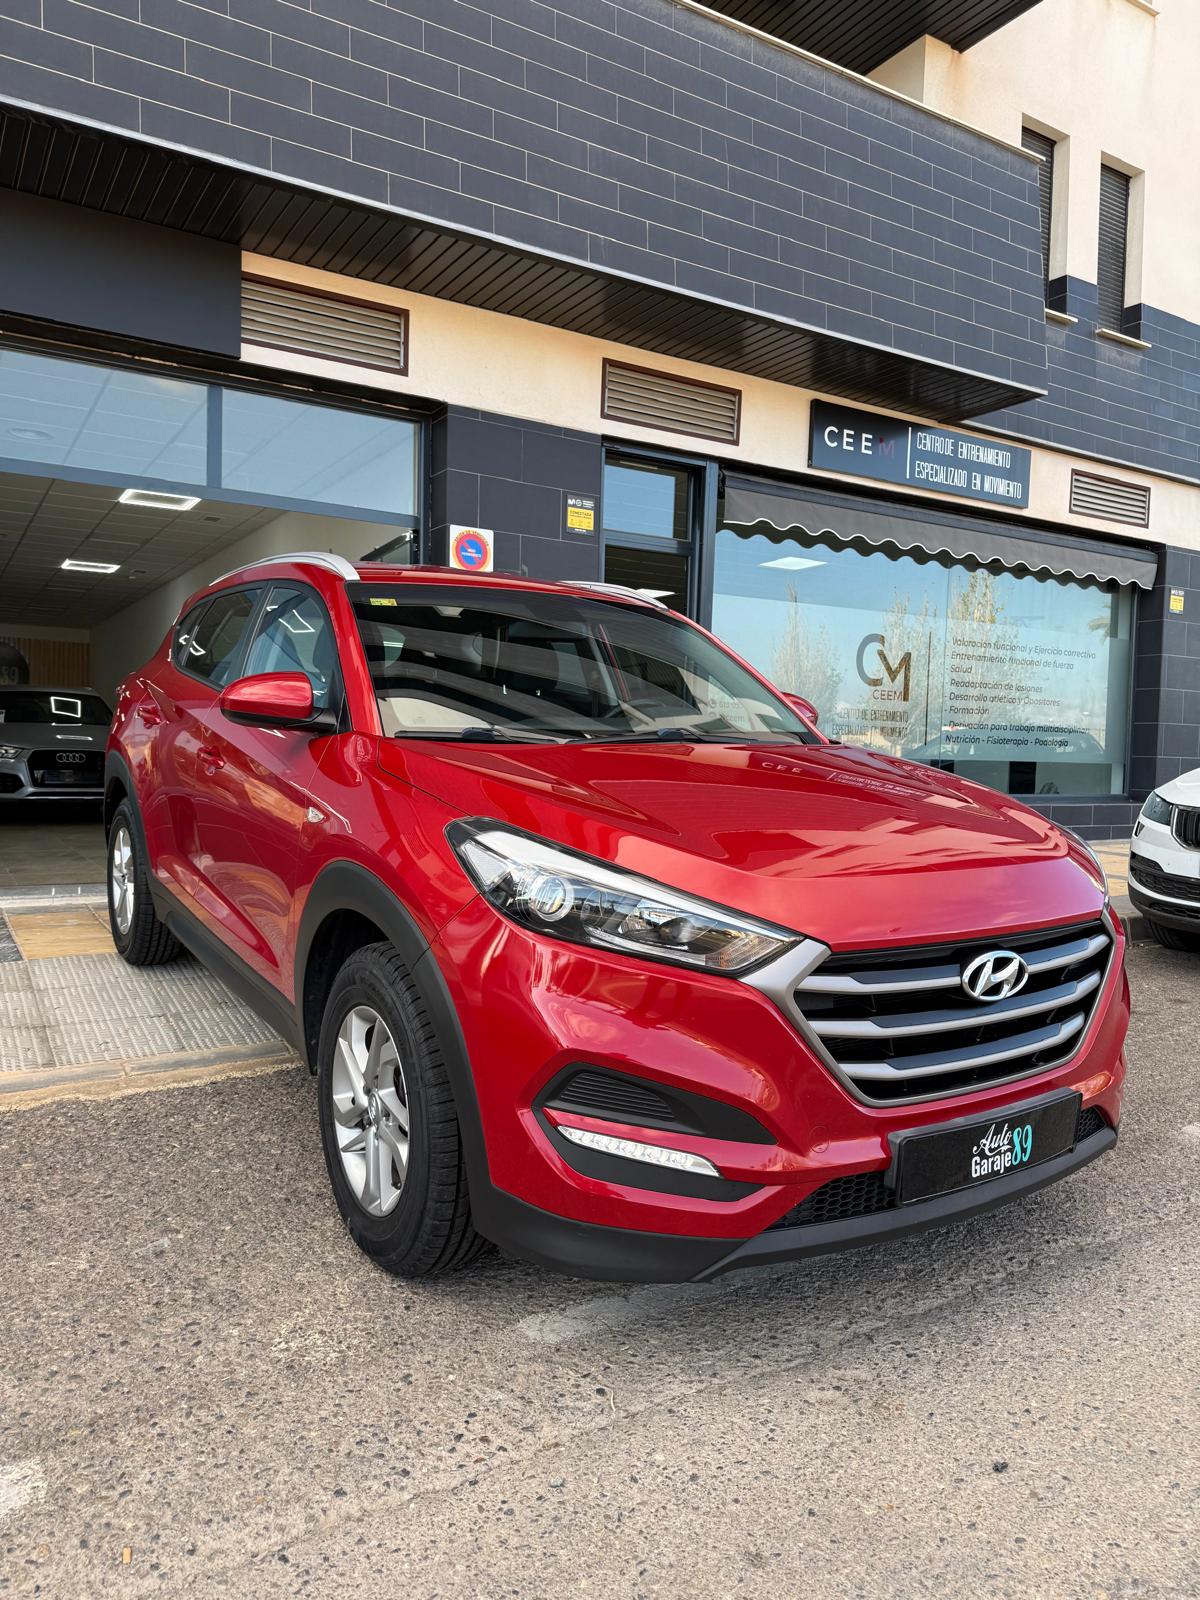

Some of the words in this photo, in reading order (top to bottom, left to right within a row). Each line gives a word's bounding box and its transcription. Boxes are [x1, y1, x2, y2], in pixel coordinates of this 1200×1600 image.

[917, 432, 944, 454] CENTRO
[944, 439, 955, 457] DE
[958, 441, 1011, 469] ENTRENAMIENTO
[915, 461, 968, 488] ESPECIALIZADO
[972, 473, 981, 491] EN
[984, 475, 1022, 499] MOVIMIENTO
[993, 641, 1028, 652] funcional
[1034, 645, 1063, 656] Ejercicio
[1064, 649, 1097, 660] correctivo
[951, 651, 1007, 664] Entrenamiento
[1008, 655, 1042, 667] funcional
[1042, 658, 1052, 668] de
[1052, 660, 1075, 670] fuerza
[950, 665, 973, 674] Salud
[951, 679, 1003, 690] Readaptación
[1004, 682, 1014, 691] de
[872, 689, 903, 701] CEEM
[949, 691, 988, 702] Desarrollo
[989, 694, 1017, 704] atlético
[949, 705, 990, 715] Formación
[989, 723, 1008, 732] para
[1009, 724, 1036, 734] trabajo
[945, 734, 981, 744] Nutrición
[987, 735, 1029, 747] Fisioterapia
[972, 1123, 1012, 1155] Auto
[971, 1149, 1012, 1178] Garaje
[1012, 1125, 1033, 1165] 89
